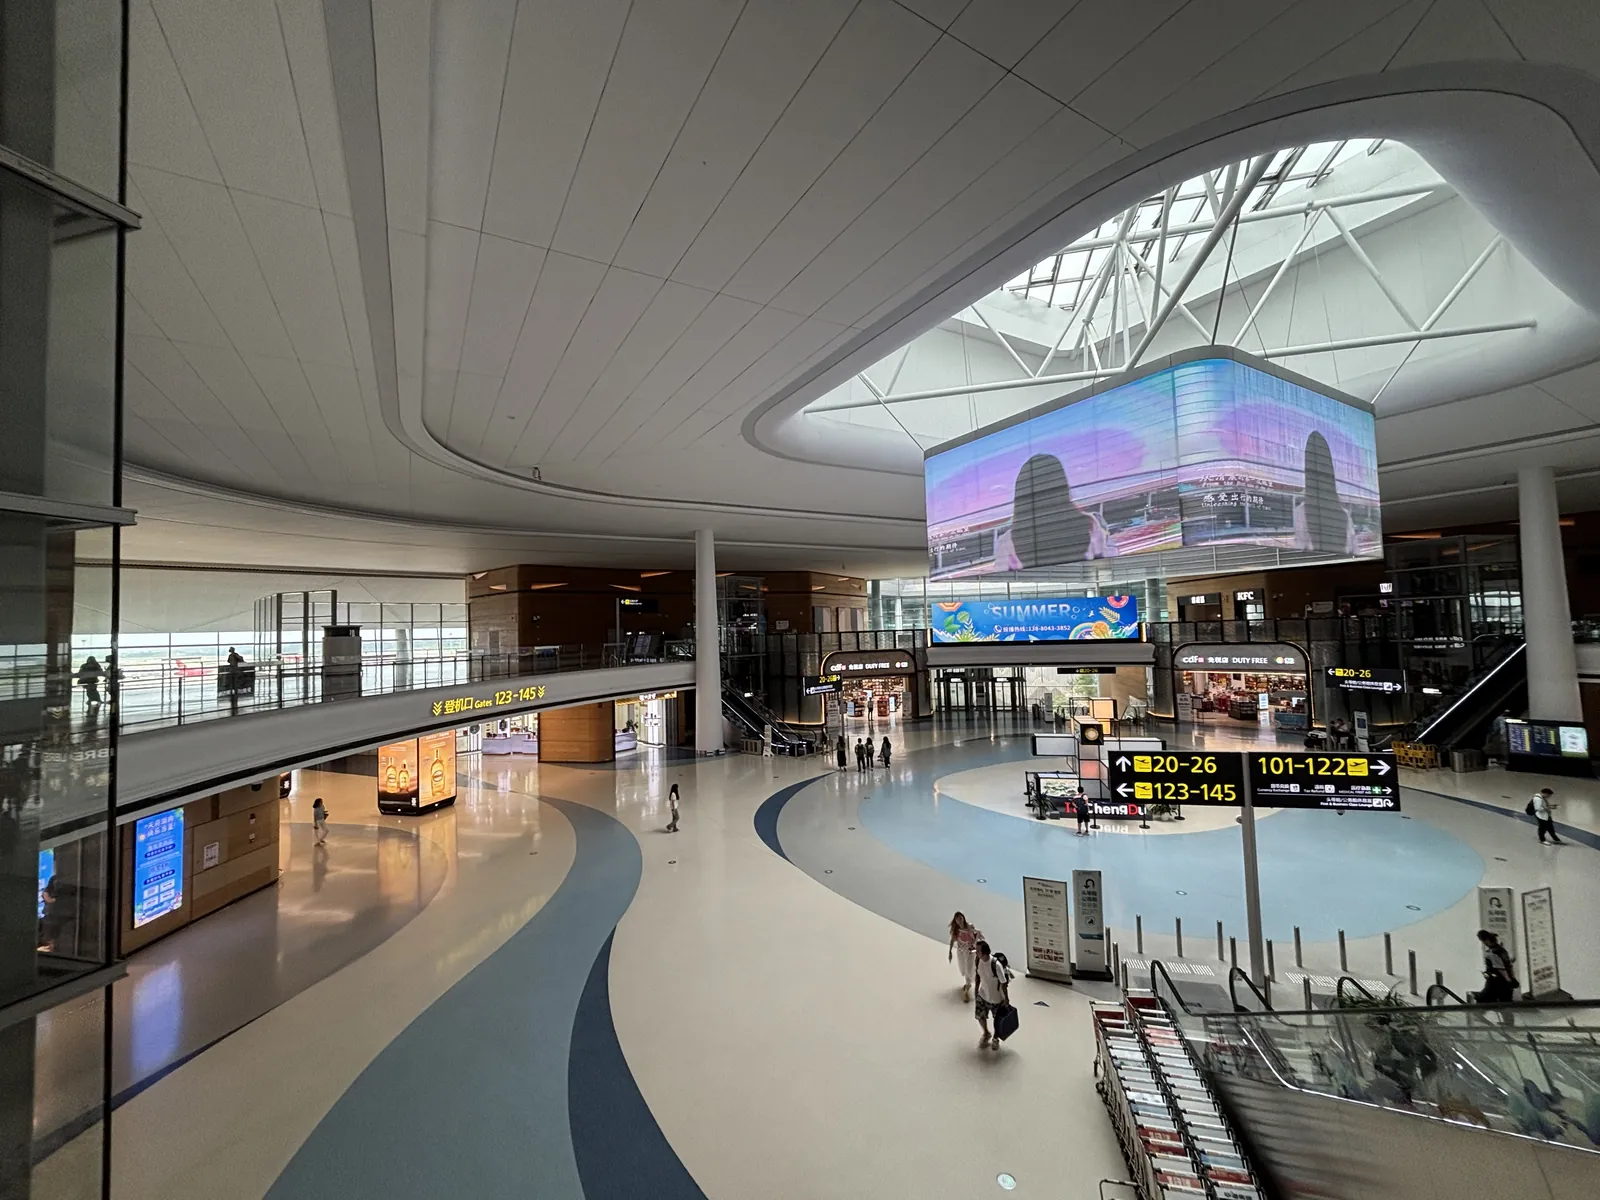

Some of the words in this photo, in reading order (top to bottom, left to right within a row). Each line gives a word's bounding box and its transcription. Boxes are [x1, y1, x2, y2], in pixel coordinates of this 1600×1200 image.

[1237, 591, 1254, 601] KFC
[992, 603, 1071, 620] SUMMER
[1232, 656, 1251, 664] DUTY
[819, 675, 833, 683] 20-26
[1343, 668, 1371, 678] 20-26
[444, 697, 473, 714] 登机口
[474, 700, 492, 709] Gates
[495, 686, 537, 706] 123-145
[1153, 755, 1217, 774] 20-26
[1258, 757, 1346, 776] 101-122
[1154, 782, 1237, 802] 123-145
